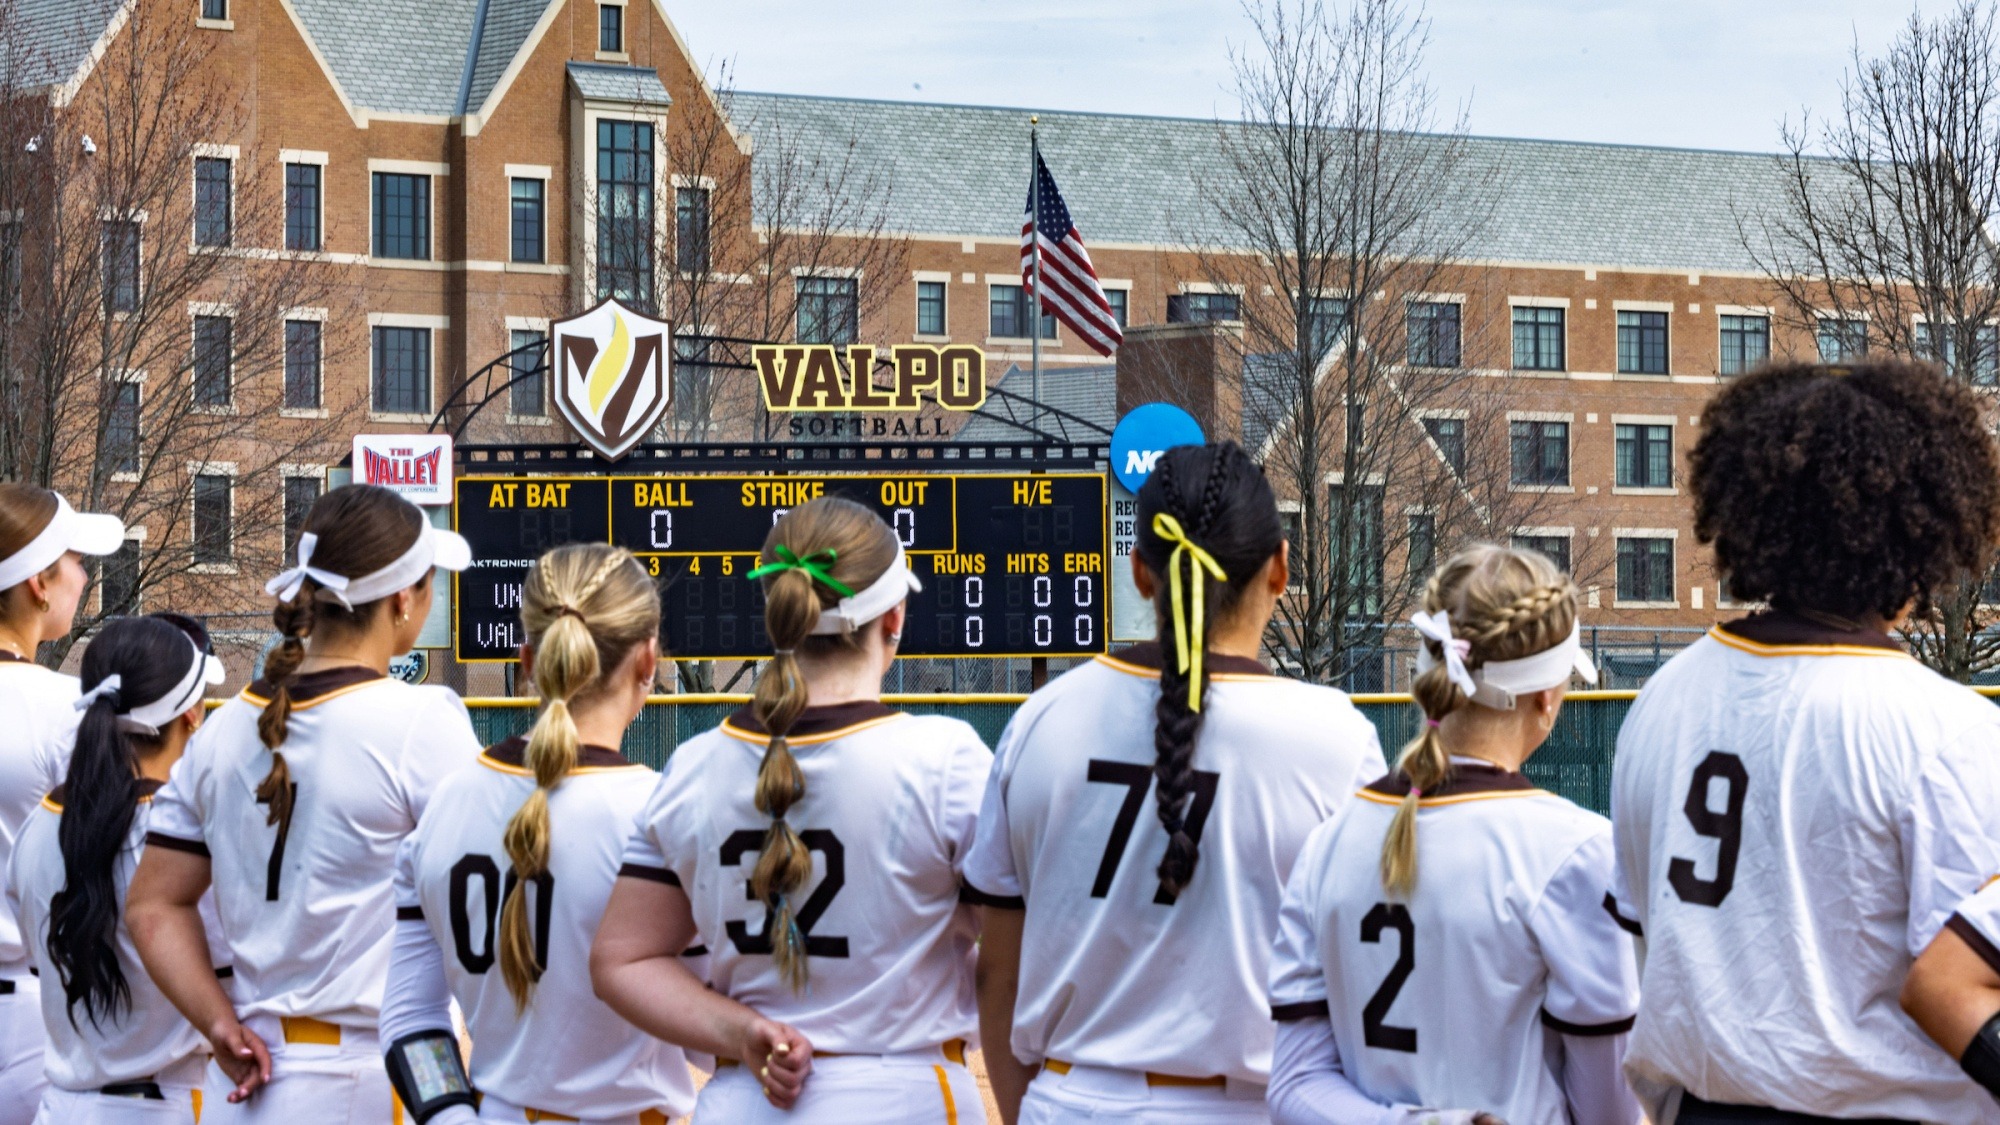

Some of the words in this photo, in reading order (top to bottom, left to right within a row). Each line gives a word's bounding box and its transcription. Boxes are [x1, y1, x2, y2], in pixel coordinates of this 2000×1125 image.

[752, 344, 986, 411] VALPO
[789, 417, 950, 436] SOFTBALL
[389, 448, 413, 456] THE
[363, 446, 442, 486] VALLEY
[489, 483, 518, 508] AT
[527, 483, 571, 508] BAT
[634, 482, 694, 508] BALL
[741, 482, 824, 506] STRIKE
[881, 481, 928, 506] OUT
[1013, 480, 1052, 507] H/E
[651, 509, 672, 548] 0
[893, 508, 915, 547] 0
[469, 559, 536, 568] AKTRONICS
[649, 556, 660, 576] 3
[689, 556, 701, 576] 4
[722, 555, 733, 576] 5
[933, 553, 986, 574] RUNS
[1007, 553, 1050, 573] HITS
[1064, 553, 1102, 573] ERR
[495, 583, 522, 609] UN
[965, 576, 983, 608] 0
[1034, 576, 1051, 607] 0
[1074, 575, 1092, 607] 0
[477, 622, 527, 648] VAL
[965, 615, 983, 647] 0
[1034, 614, 1052, 646] 0
[1075, 614, 1093, 646] 0
[1087, 759, 1220, 905] 77
[1668, 751, 1749, 907] 9
[720, 829, 849, 958] 32
[1360, 902, 1418, 1053] 2
